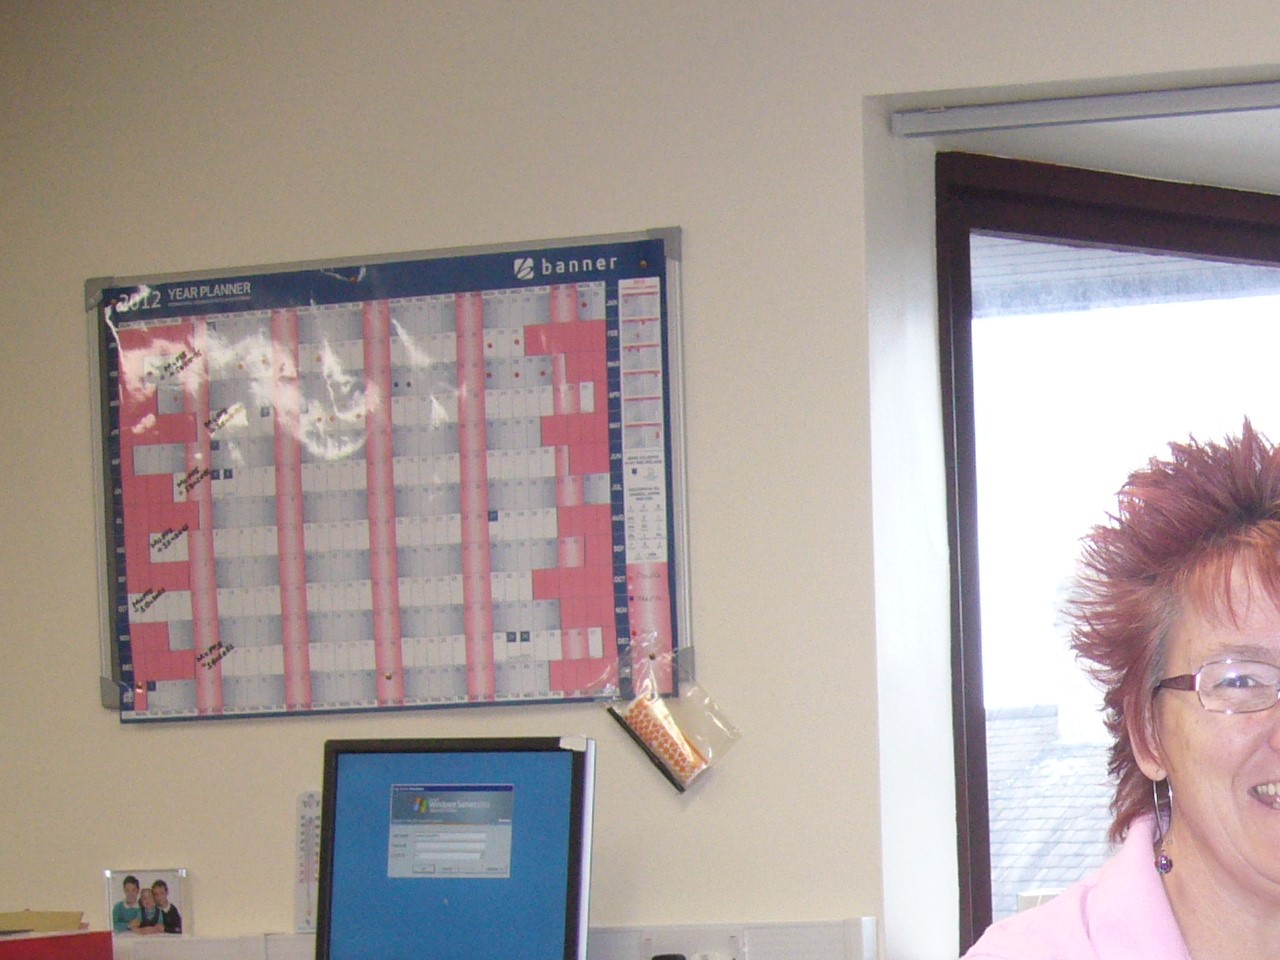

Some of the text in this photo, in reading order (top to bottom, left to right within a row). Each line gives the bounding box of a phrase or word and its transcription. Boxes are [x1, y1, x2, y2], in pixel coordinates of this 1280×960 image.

[541, 256, 619, 276] banner
[116, 281, 252, 313] 2012 YEAR PLANNER
